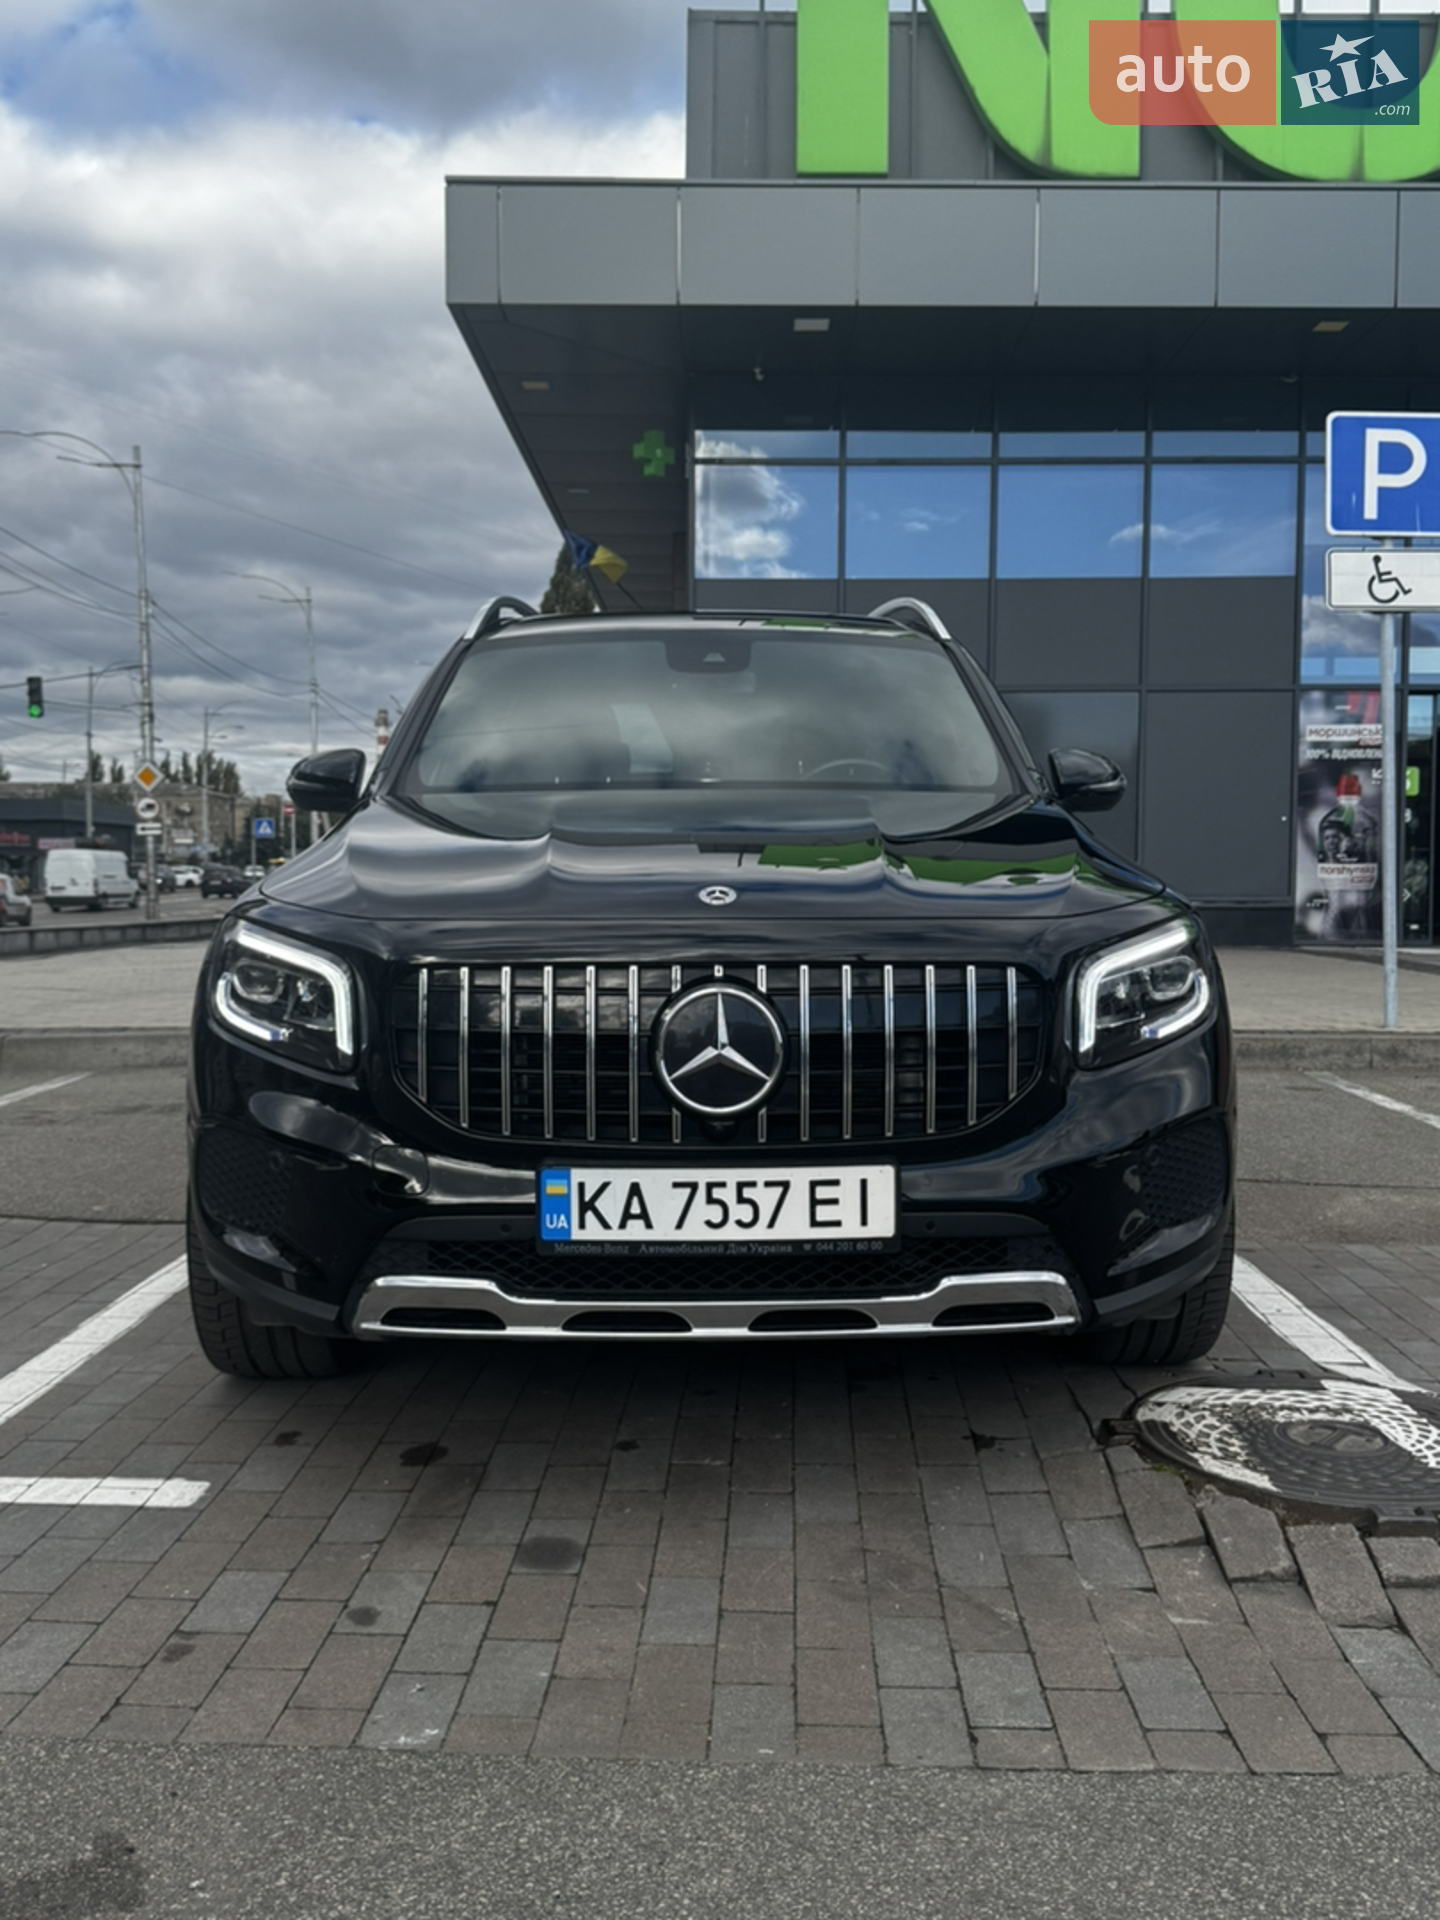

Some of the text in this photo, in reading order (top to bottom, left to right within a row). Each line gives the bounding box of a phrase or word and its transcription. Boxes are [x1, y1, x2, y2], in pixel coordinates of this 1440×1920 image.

[1363, 427, 1428, 520] P
[1308, 727, 1383, 738] моршинськ
[545, 1213, 569, 1230] UA
[671, 1179, 791, 1230] 7557
